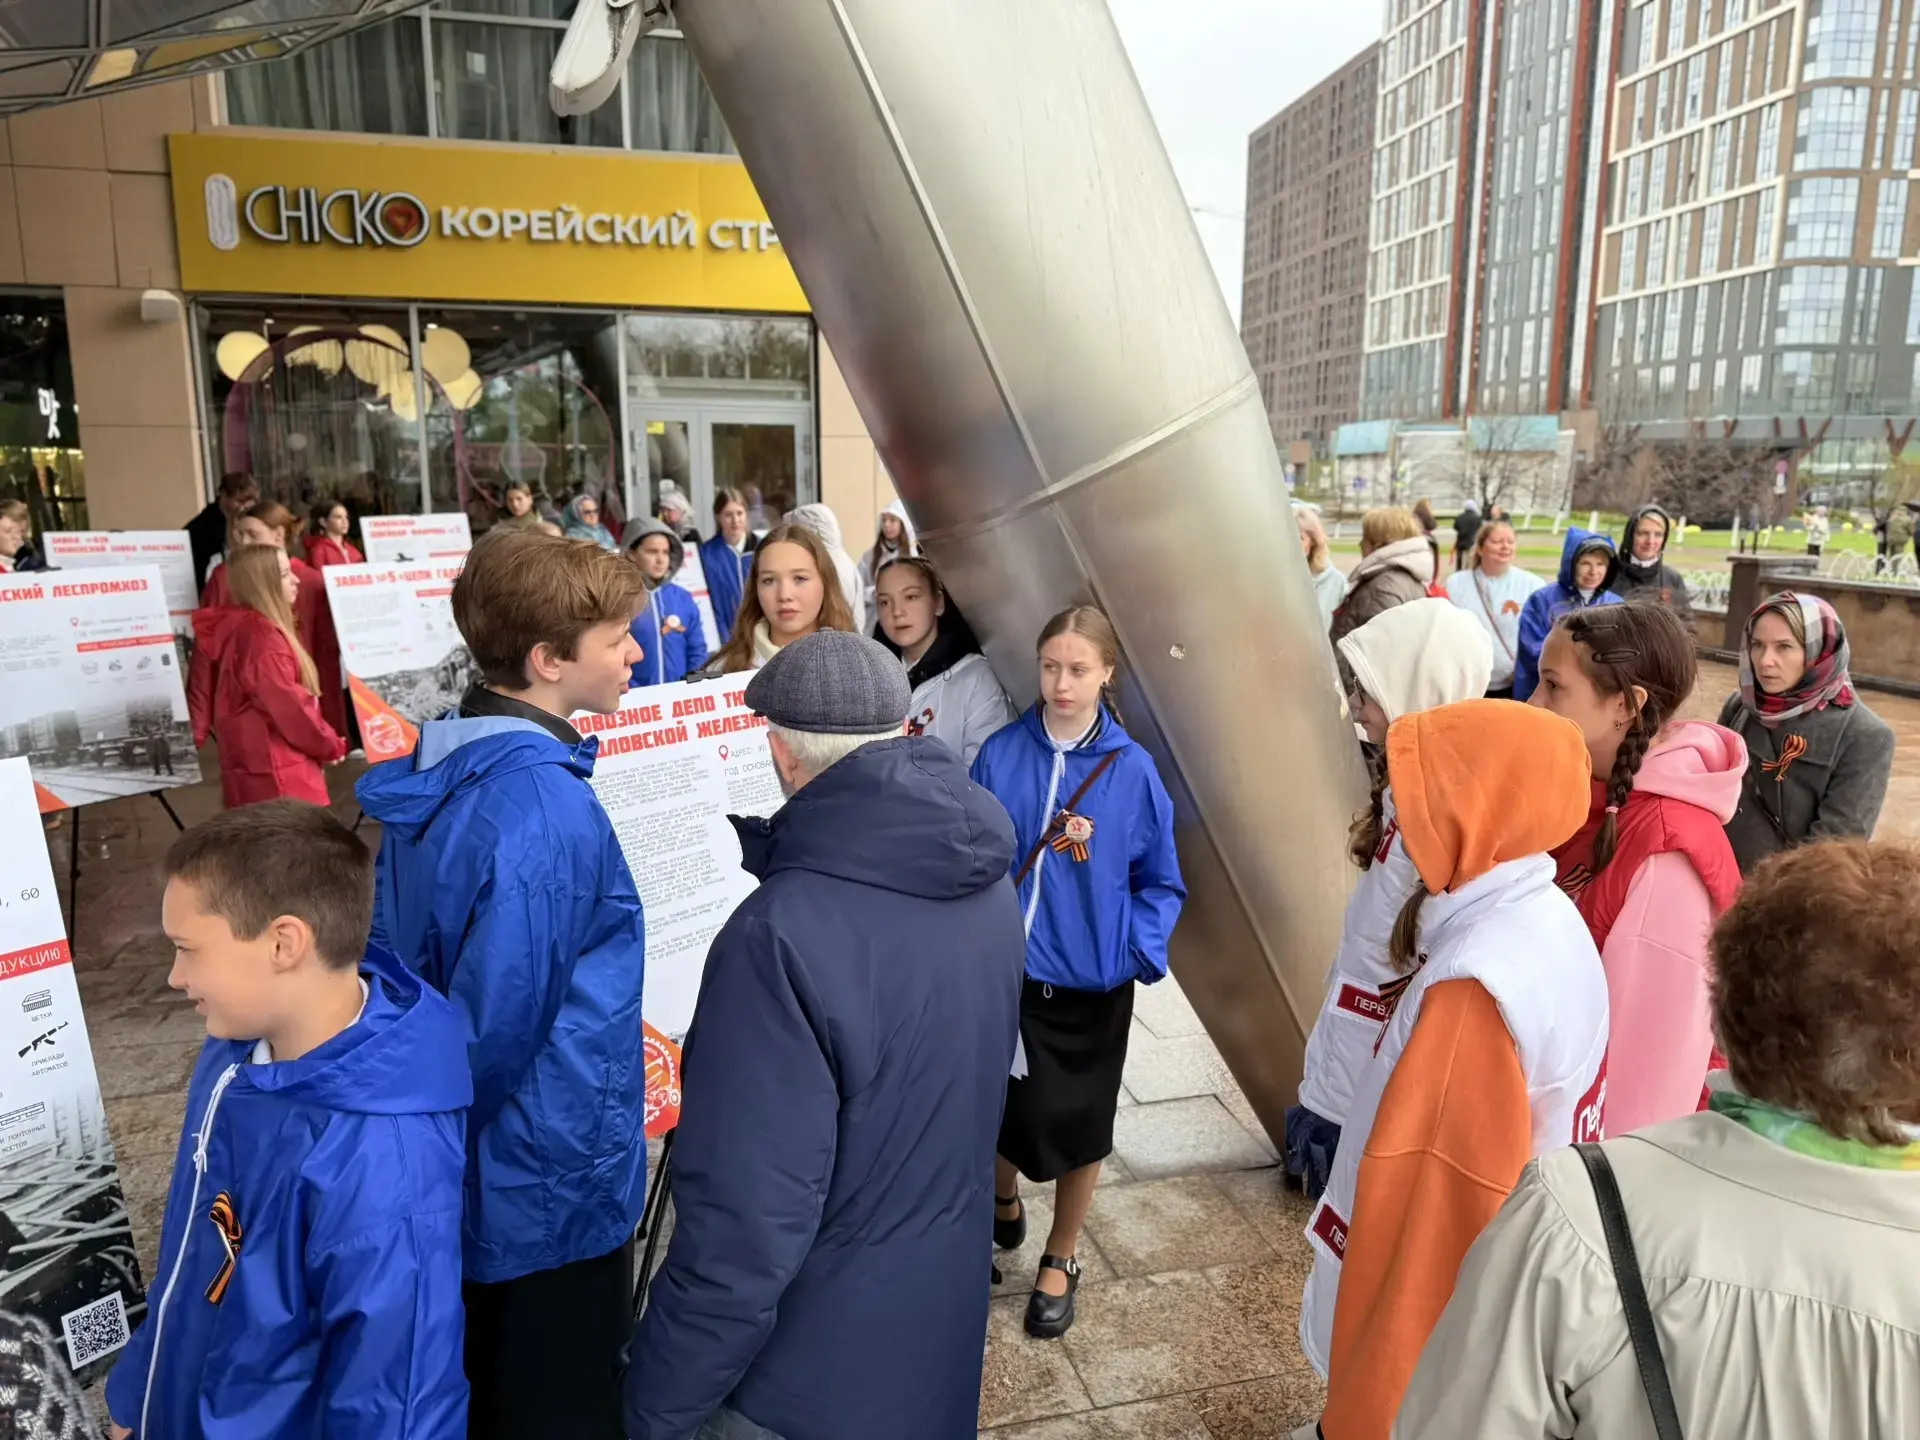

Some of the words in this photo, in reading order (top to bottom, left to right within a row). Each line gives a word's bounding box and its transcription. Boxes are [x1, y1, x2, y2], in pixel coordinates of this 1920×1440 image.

[245, 185, 430, 247] CHICKO
[441, 204, 697, 248] КОРЕЙСКИЙ
[0, 583, 44, 602] СКИЙ
[52, 579, 149, 598] ЛЕСПРОМХОЗ
[671, 695, 717, 719] ДЕПО
[724, 765, 739, 777] ГОД
[20, 887, 40, 901] 60
[31, 1052, 65, 1067] ПРИКЛАДЫ
[31, 1061, 69, 1077] АВТОМАТОВ
[8, 1123, 46, 1142] ПОНТОННЫХ
